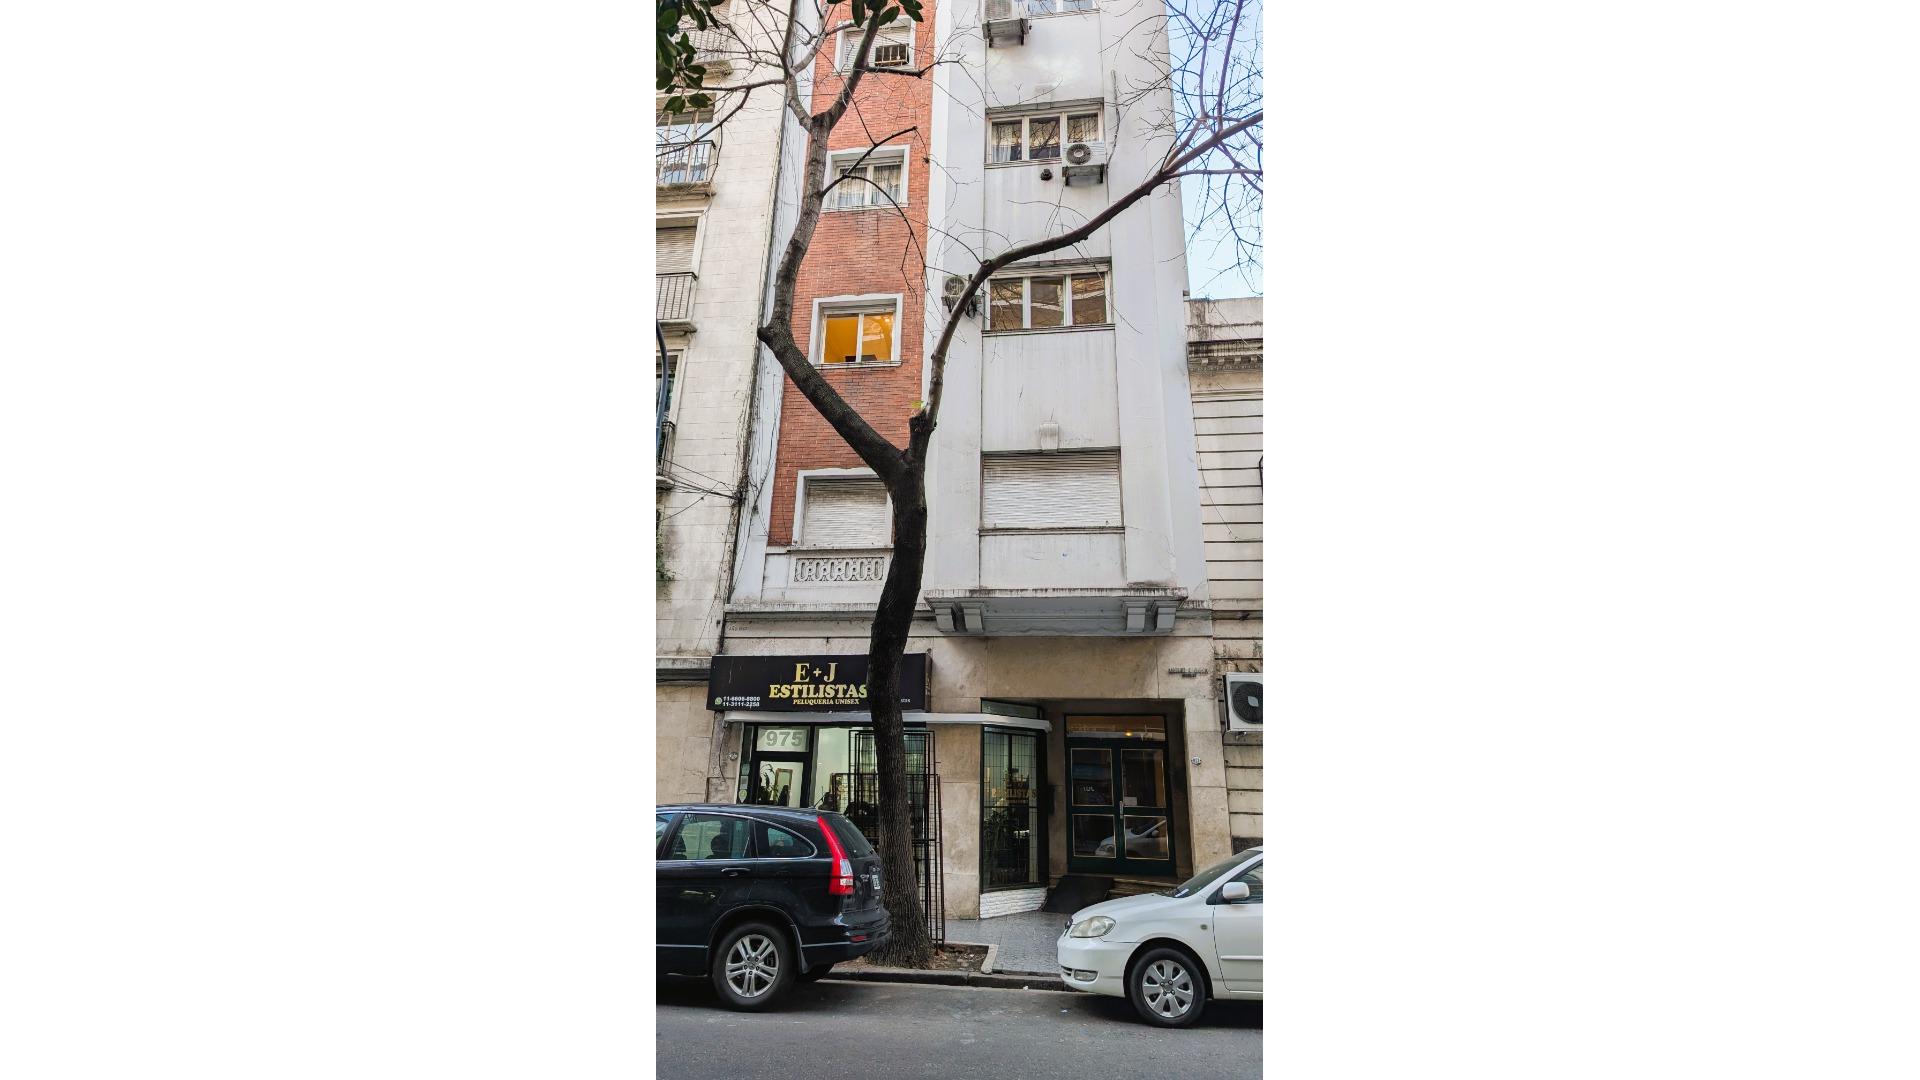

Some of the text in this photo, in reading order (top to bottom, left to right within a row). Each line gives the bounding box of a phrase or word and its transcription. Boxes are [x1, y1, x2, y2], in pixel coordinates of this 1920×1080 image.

[769, 684, 868, 698] ESTILISTAS
[793, 698, 834, 706] PELUQUERIA
[766, 730, 803, 747] 975
